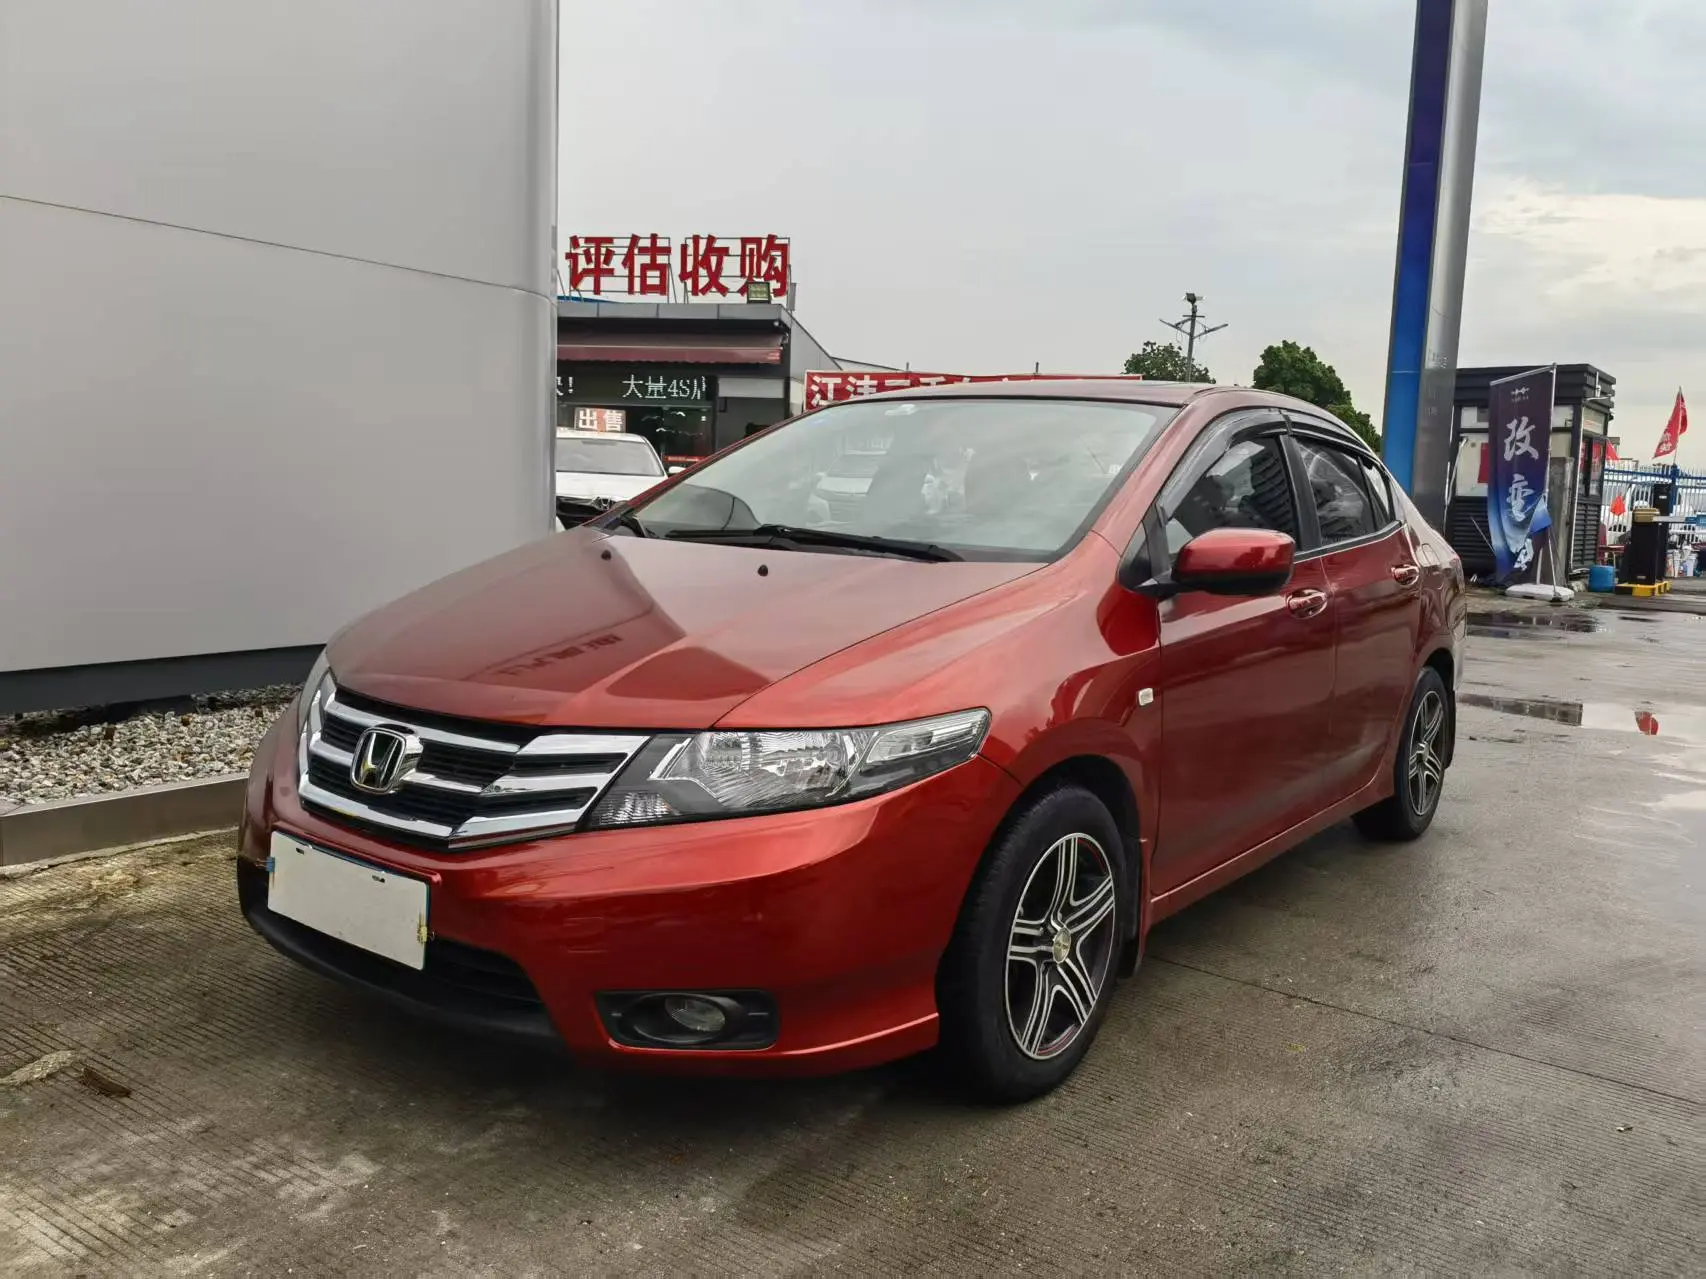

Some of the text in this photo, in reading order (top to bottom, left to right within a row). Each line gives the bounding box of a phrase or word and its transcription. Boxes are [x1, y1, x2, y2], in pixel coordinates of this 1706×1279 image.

[565, 234, 788, 297] 评估收购
[578, 408, 623, 432] 出售
